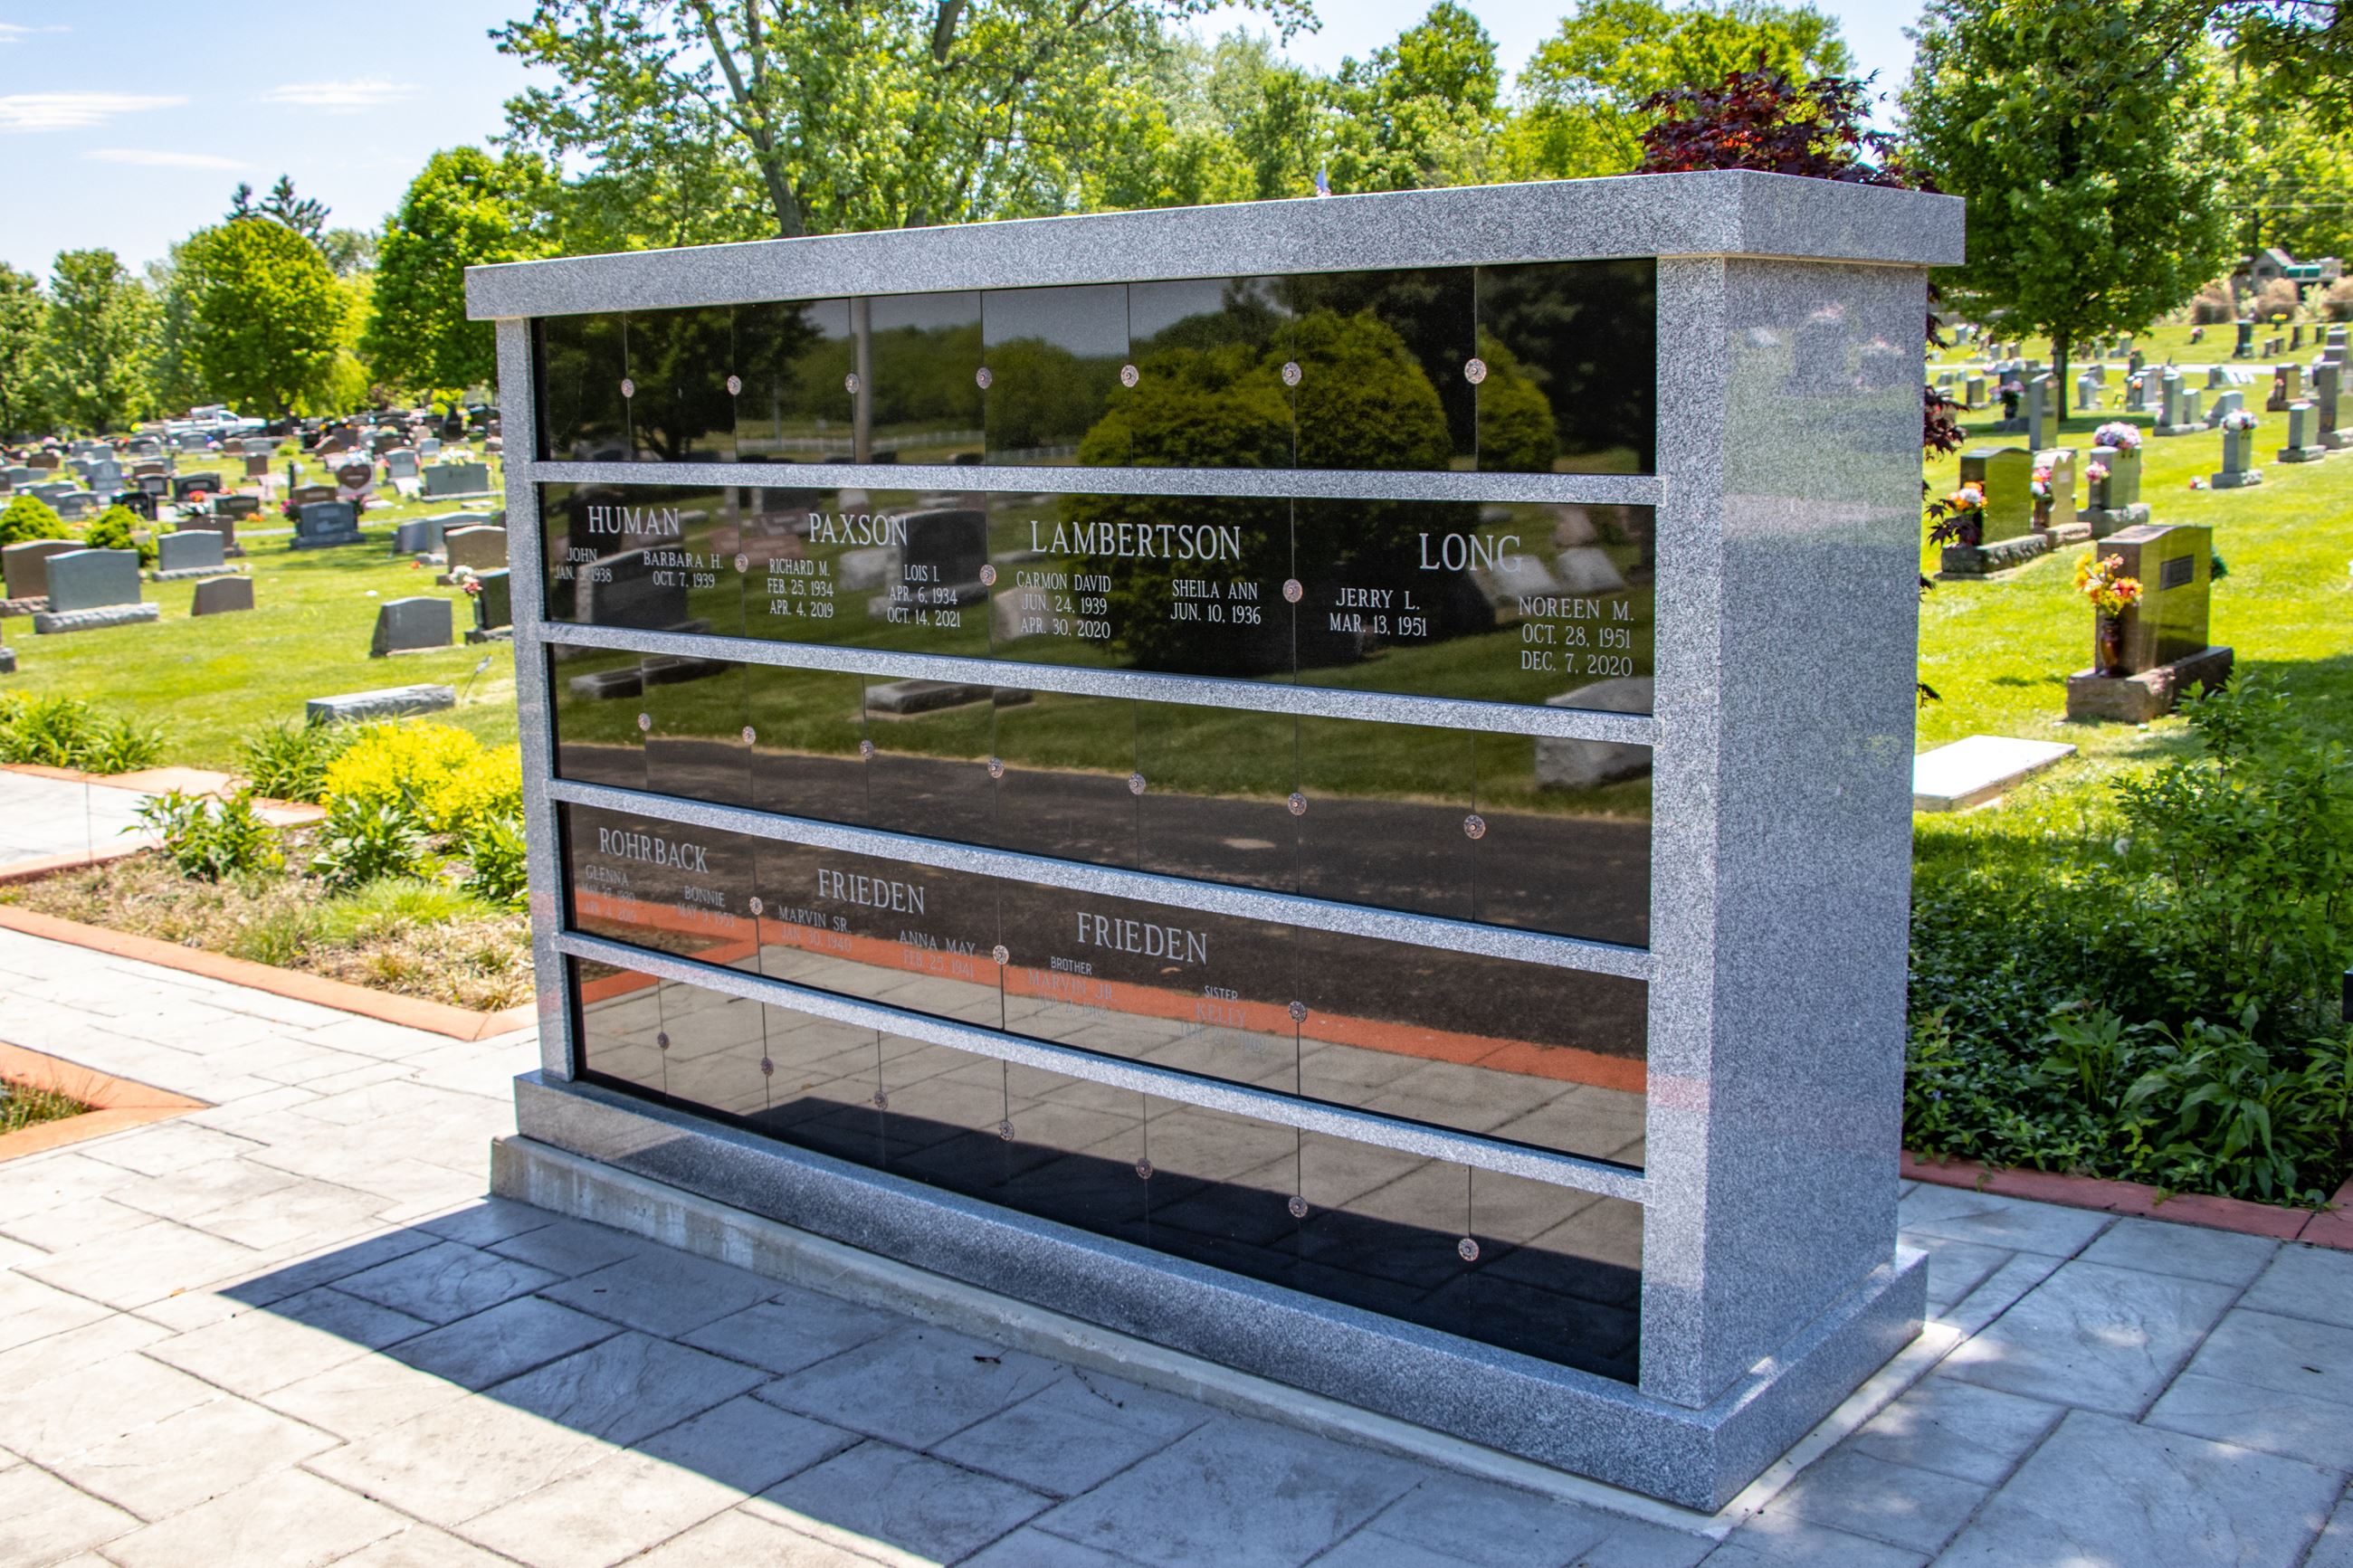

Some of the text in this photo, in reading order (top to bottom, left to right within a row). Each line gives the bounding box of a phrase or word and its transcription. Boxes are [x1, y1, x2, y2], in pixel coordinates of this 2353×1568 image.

[587, 506, 679, 536] HUMAN
[808, 513, 908, 546] PAXSON
[1030, 520, 1241, 560] LAMBERTSON
[567, 546, 597, 562] JOHN
[643, 550, 723, 569] BARBARA H.
[1419, 532, 1523, 573] LONG
[554, 565, 575, 580] JAN.
[591, 566, 613, 583] 1938
[769, 558, 831, 576] RICHARD M.
[904, 565, 940, 582] LOIS I.
[653, 571, 675, 586] OCT.
[693, 573, 715, 589] 1939
[767, 578, 787, 594] FEB.
[811, 581, 834, 597] 1934
[1016, 570, 1111, 593] CARMON DAVID
[1172, 579, 1258, 600] SHEILA ANN
[889, 585, 912, 602] APR.
[933, 587, 957, 604] 1934
[1022, 594, 1050, 612] JUN.
[1081, 597, 1107, 615] 1939
[1336, 587, 1420, 610] JERRY L.
[769, 599, 792, 615] APR.
[811, 602, 834, 618] 2019
[888, 606, 910, 623] OCT.
[935, 610, 960, 627] 2021
[1170, 602, 1202, 621] JUN.
[1232, 605, 1262, 624] 1936
[1519, 596, 1634, 622] NOREEN M.
[1021, 617, 1046, 634] APR.
[1077, 620, 1110, 639] 2020
[1329, 613, 1366, 632] MAR.
[1397, 616, 1427, 637] 1951
[1522, 623, 1631, 649] OCT. 28, 1951
[1521, 651, 1557, 671] DEC.
[1587, 654, 1633, 677] 2020
[599, 827, 710, 874] ROHRBACK
[586, 864, 629, 888] GLENNA
[684, 885, 726, 908] BONNIE
[817, 868, 926, 915] FRIEDEN
[778, 904, 852, 934] MARVIN SR.
[899, 929, 976, 957] ANNA MAY
[1077, 911, 1208, 965] FRIEDEN
[1050, 956, 1092, 976] BROTHER
[1028, 968, 1086, 994] MARVIN
[1204, 985, 1238, 1003] SISTER
[1195, 1002, 1245, 1027] KELLY
